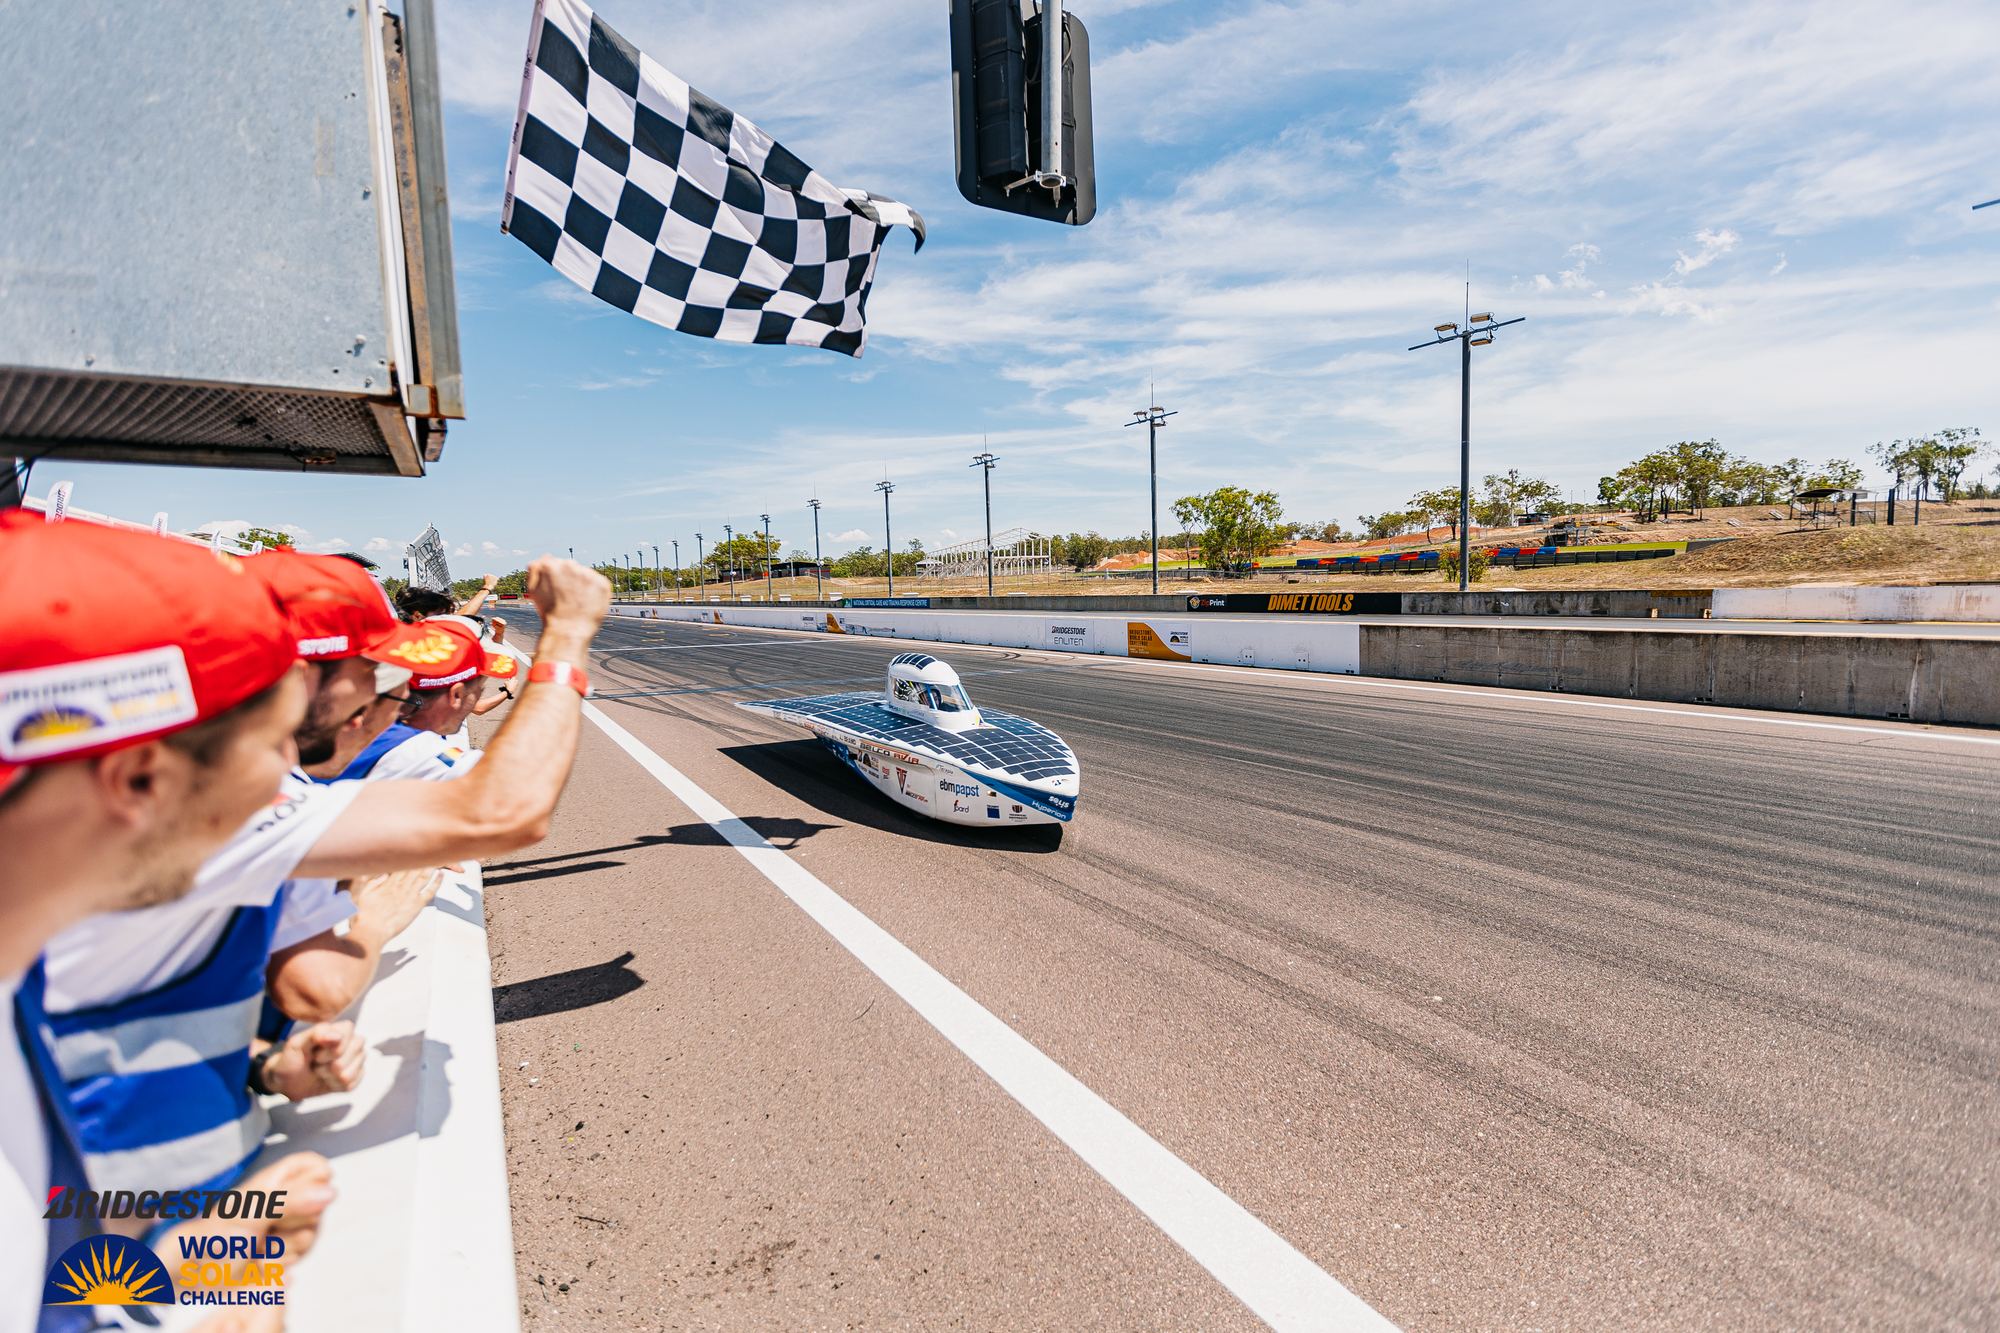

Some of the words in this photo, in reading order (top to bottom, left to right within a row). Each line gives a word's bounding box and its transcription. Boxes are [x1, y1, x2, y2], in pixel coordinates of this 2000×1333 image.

[1267, 594, 1309, 611] DIMET
[1309, 594, 1354, 611] TOOLS
[1052, 625, 1087, 635] BRIDGESTONE
[940, 779, 980, 798] ebmpapst
[1031, 800, 1067, 819] Hyperion
